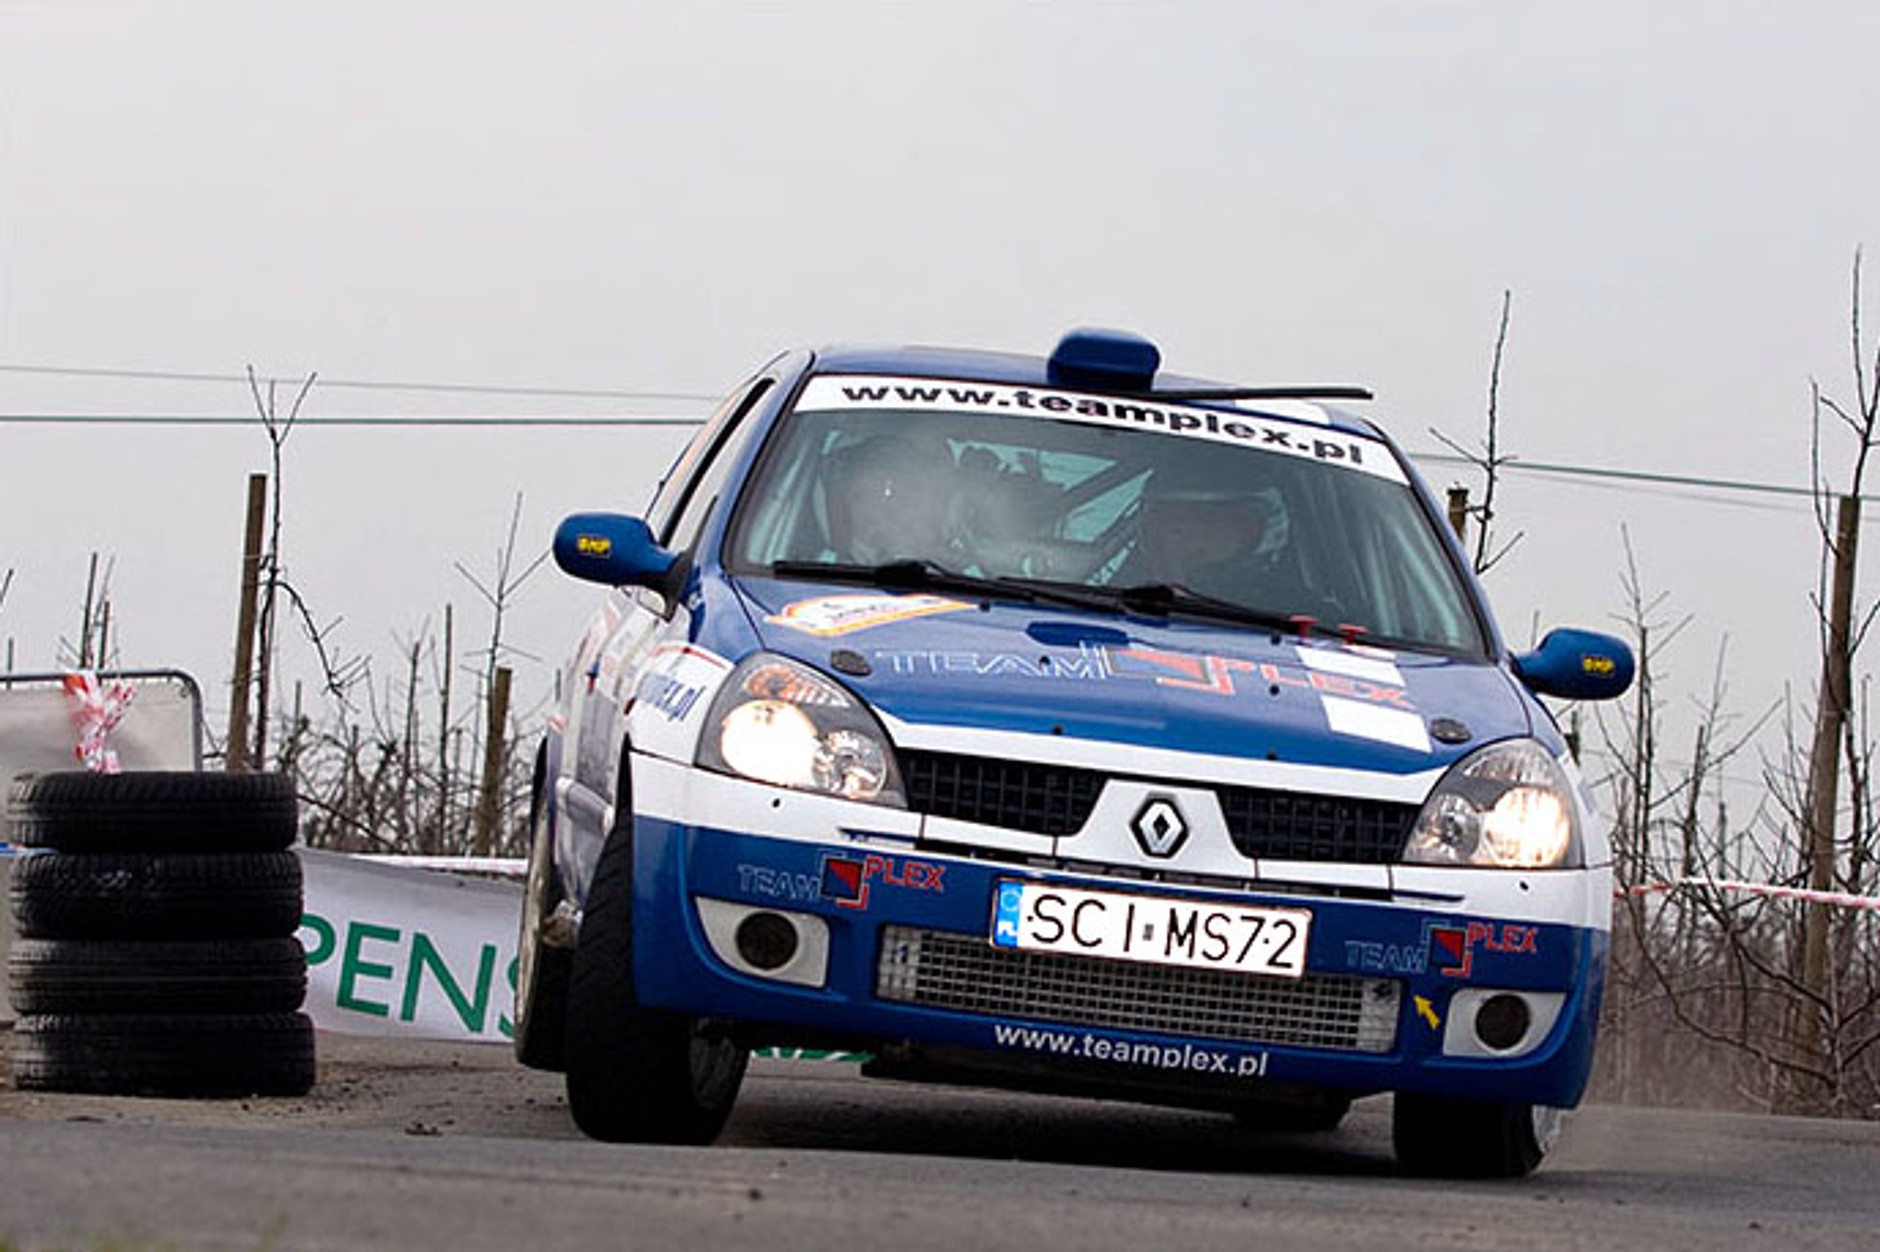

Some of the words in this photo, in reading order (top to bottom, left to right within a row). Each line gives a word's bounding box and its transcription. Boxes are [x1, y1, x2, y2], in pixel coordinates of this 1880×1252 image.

[842, 386, 1362, 464] www.teamplex.pl
[737, 864, 822, 902] TEAM
[864, 855, 947, 892] PLEX
[1345, 941, 1428, 974] TEAM
[1467, 921, 1539, 954] PLEX
[994, 1024, 1268, 1077] www.teamplex.pl
